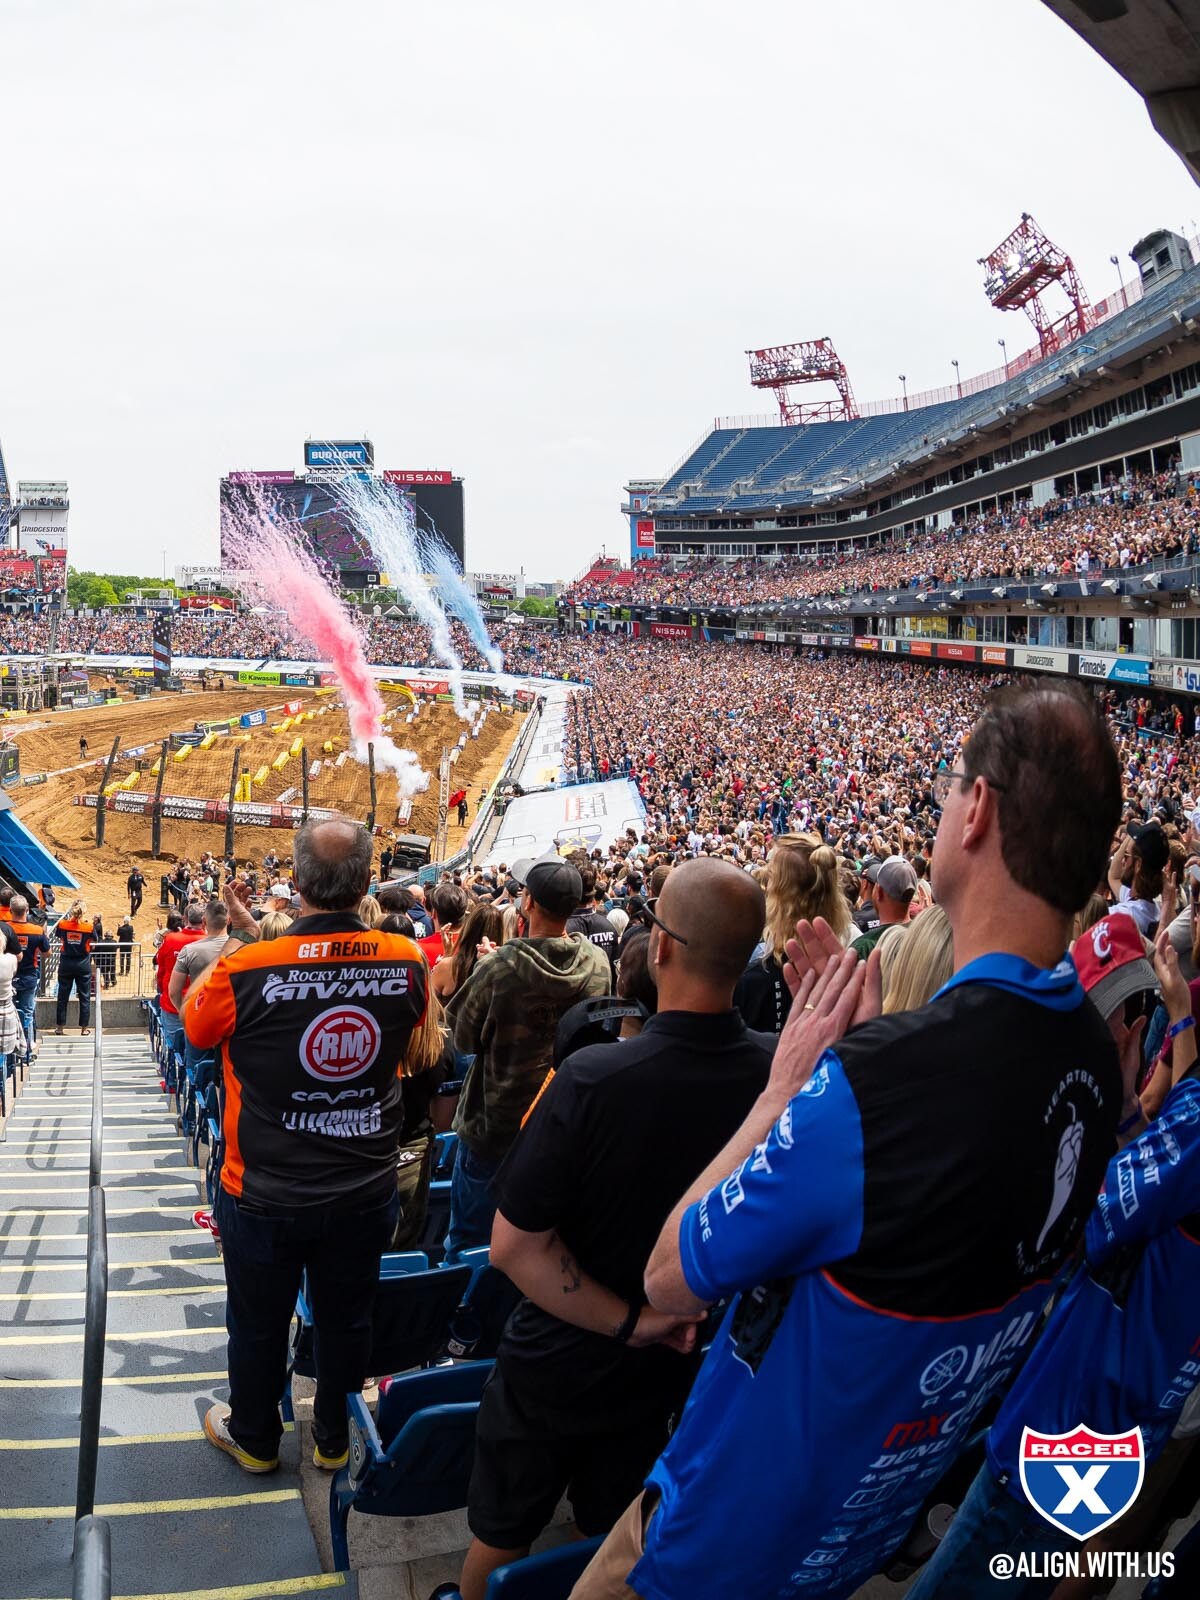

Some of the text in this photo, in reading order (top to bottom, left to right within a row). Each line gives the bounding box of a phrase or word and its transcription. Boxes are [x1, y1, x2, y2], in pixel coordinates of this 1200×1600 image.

[311, 450, 362, 459] BUD LIGHT
[391, 474, 443, 482] NISSAN
[474, 573, 516, 581] NISSAN
[655, 627, 687, 636] NISSAN
[1079, 655, 1107, 677] Pinnacle
[287, 967, 408, 983] ROCKY MOUNTAIN
[320, 1031, 369, 1061] RM
[1118, 1153, 1139, 1217] MOTUL
